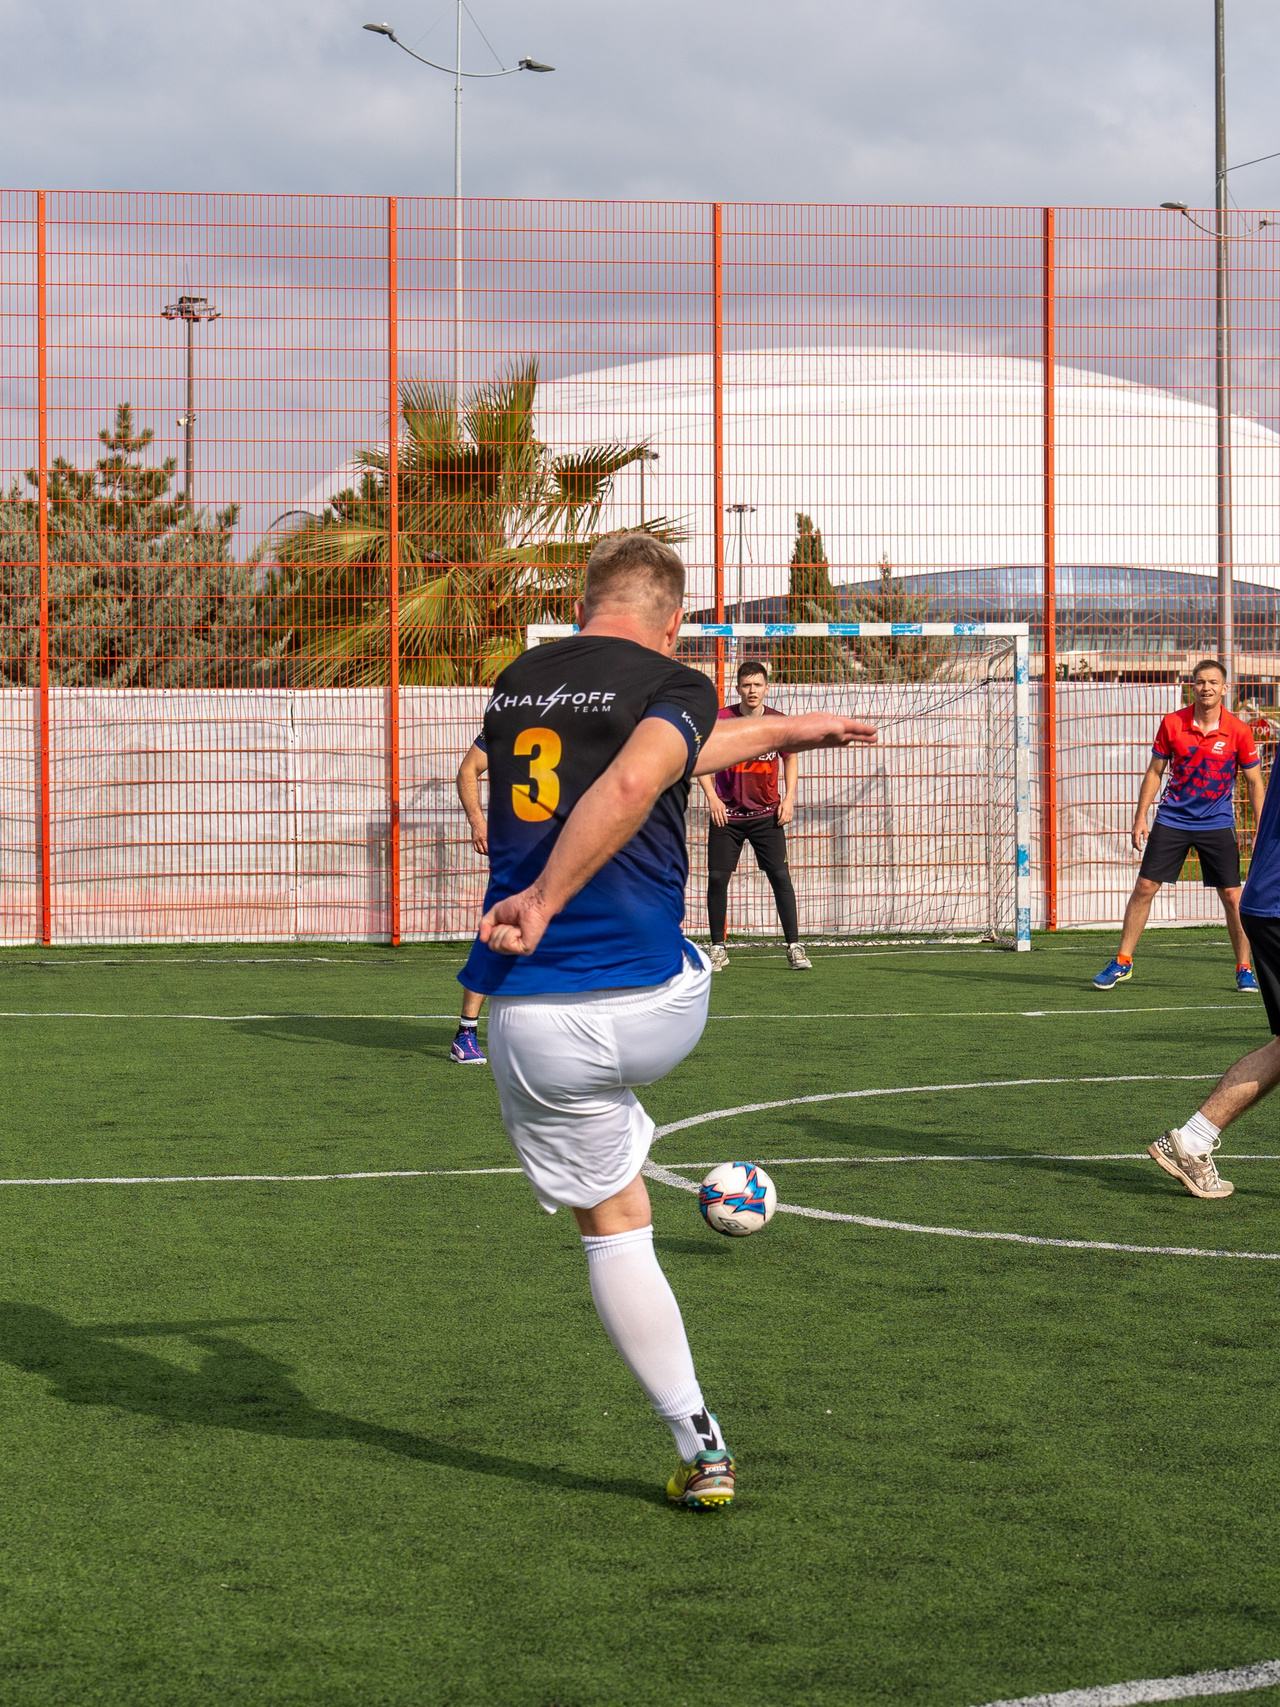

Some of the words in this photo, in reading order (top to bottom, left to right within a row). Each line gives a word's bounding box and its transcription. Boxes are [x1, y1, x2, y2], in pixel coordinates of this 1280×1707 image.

[573, 705, 611, 713] TEAM
[1250, 725, 1270, 737] TOP
[511, 727, 562, 823] 3
